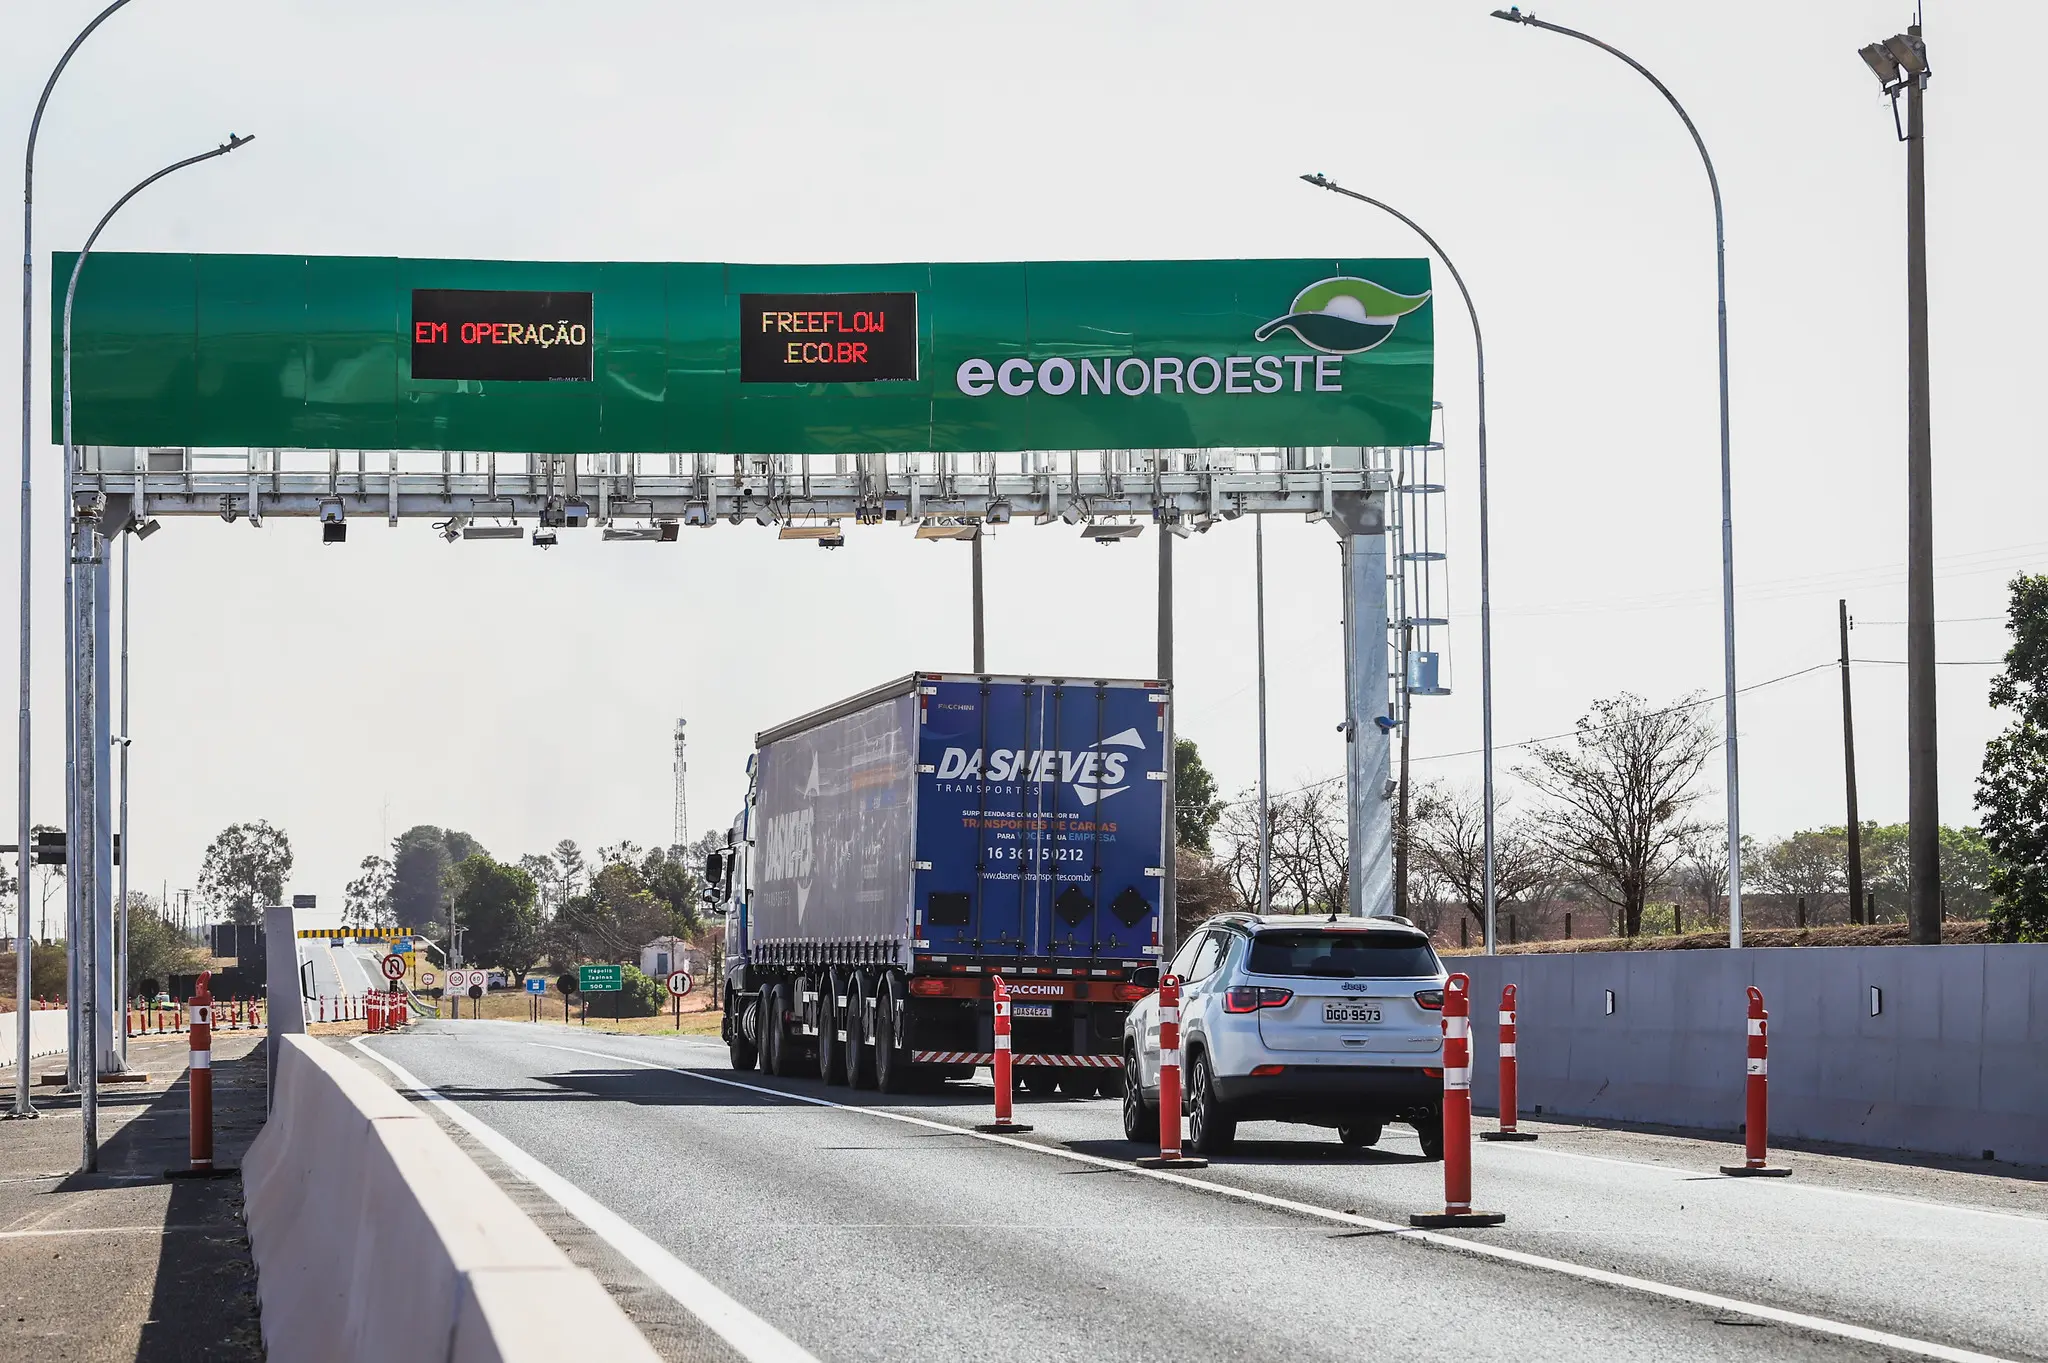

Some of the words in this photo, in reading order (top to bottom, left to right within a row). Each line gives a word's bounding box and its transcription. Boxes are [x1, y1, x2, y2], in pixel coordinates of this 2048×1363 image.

[762, 311, 884, 333] FREEFLOW
[415, 322, 448, 344] EM
[461, 320, 586, 348] OPERAÇÃO
[783, 342, 868, 363] .ECO.BR
[956, 355, 1343, 396] ecoNOROESTE
[938, 703, 975, 711] FACCHINI
[936, 747, 1128, 785] DASNEVES
[962, 810, 1015, 818] SURPEENDA-SE
[997, 832, 1016, 840] PARA
[987, 847, 1003, 859] 16
[977, 870, 1092, 883] ww.dasnevstranspotes.com.br
[1005, 985, 1064, 995] FACCHINI
[1341, 982, 1368, 992] Jeep
